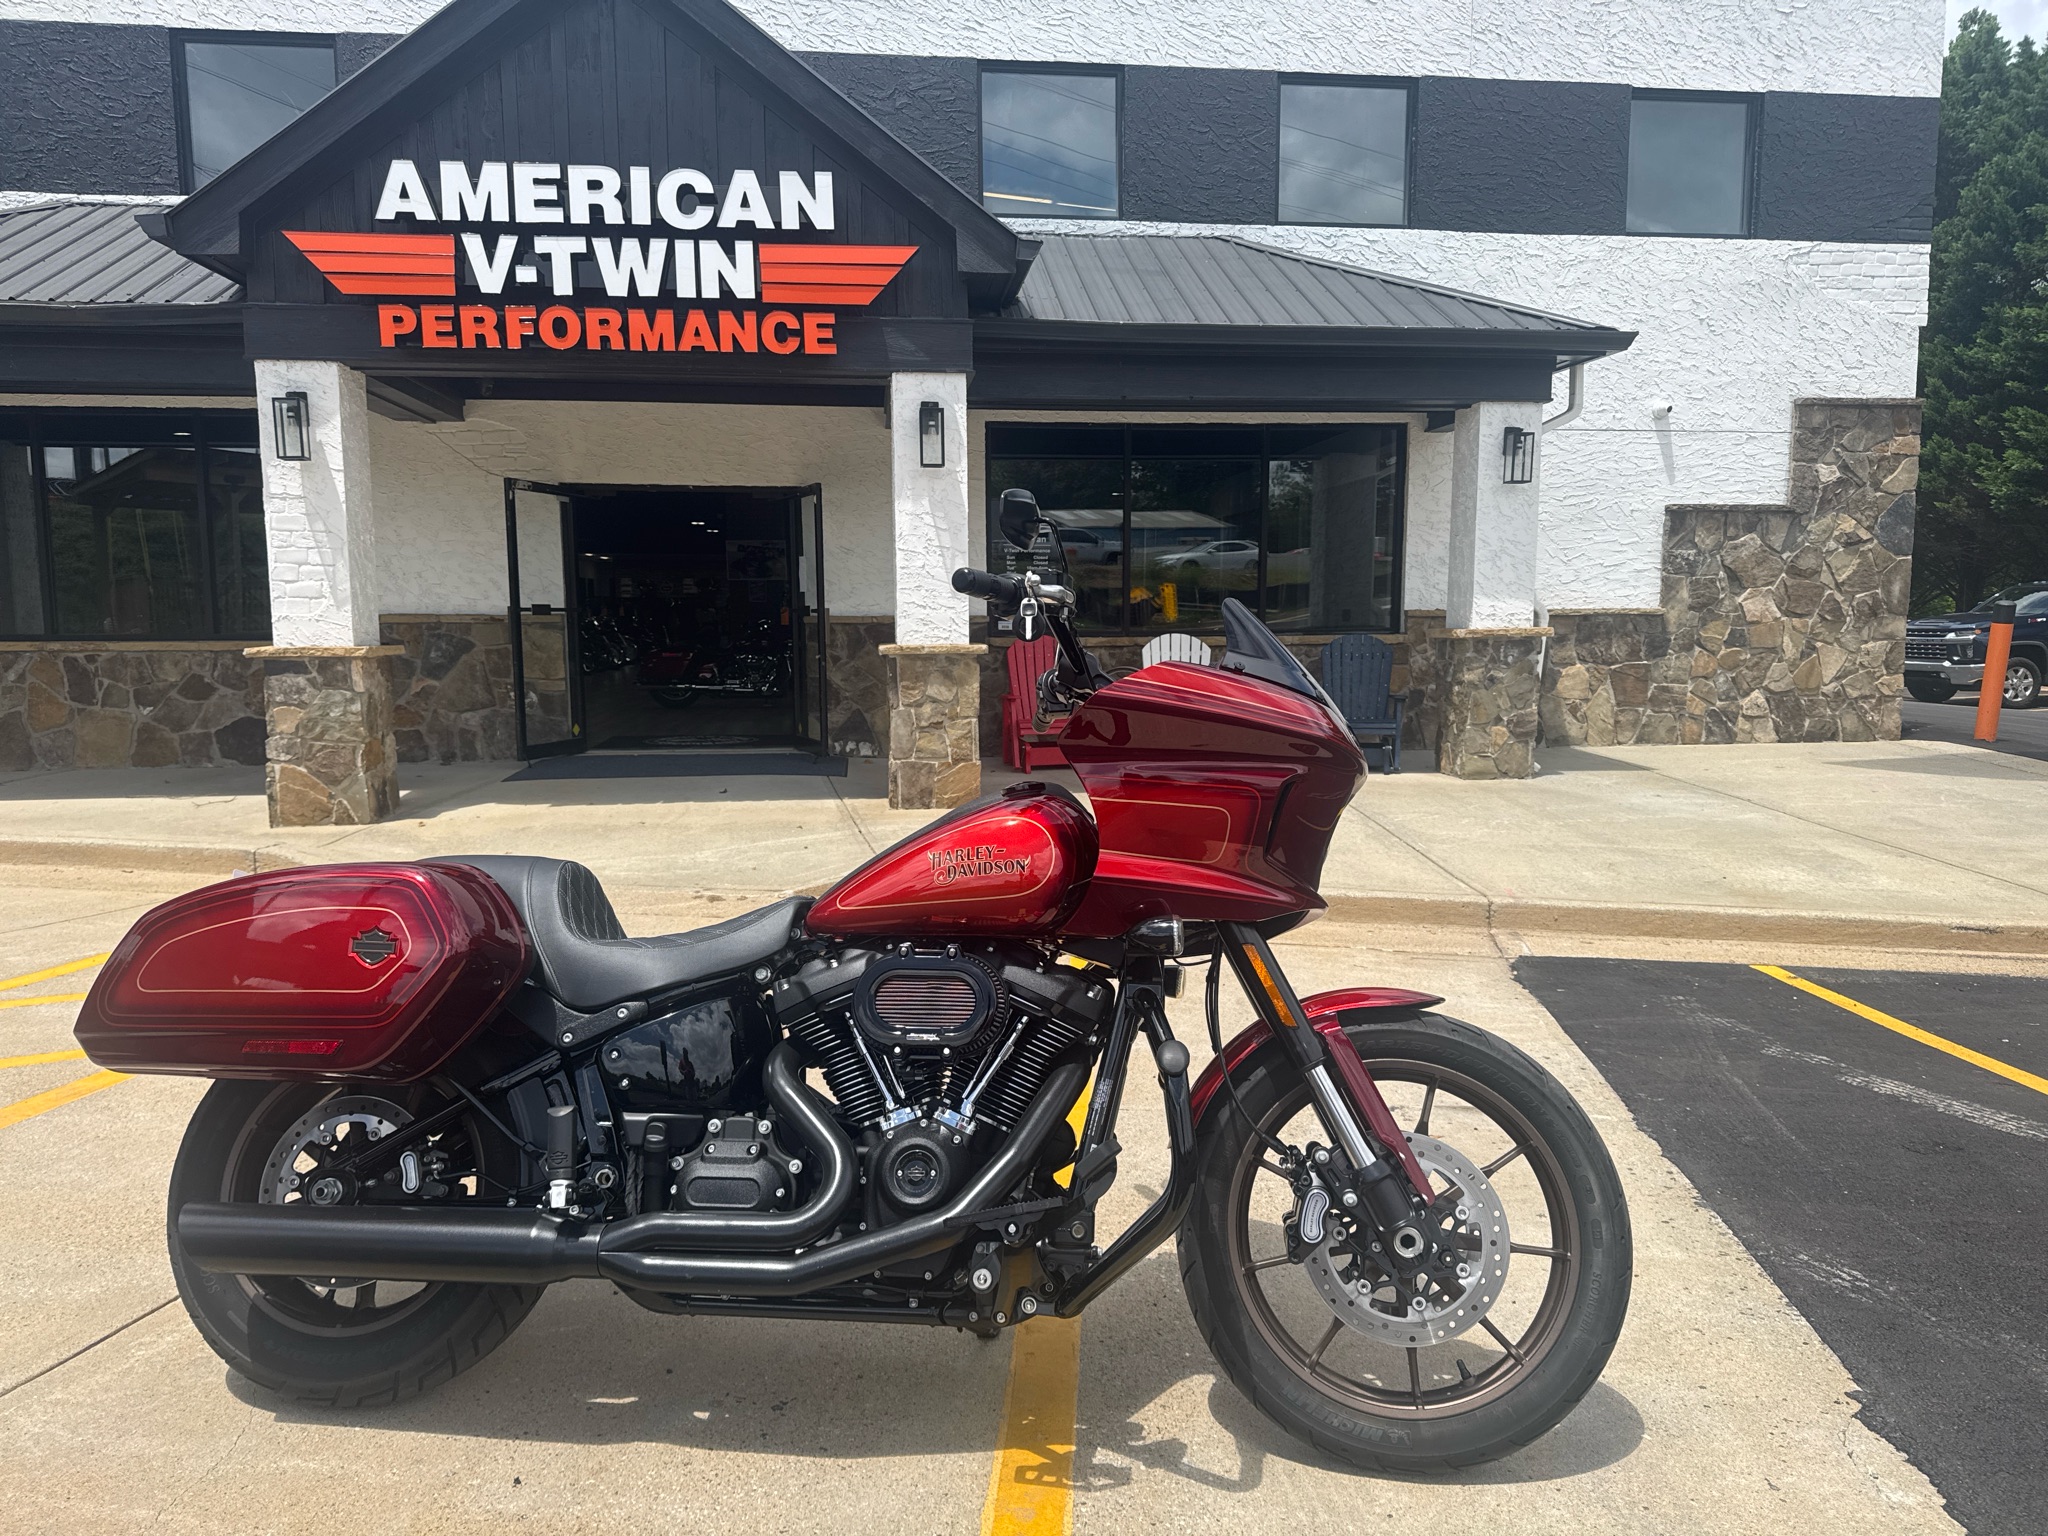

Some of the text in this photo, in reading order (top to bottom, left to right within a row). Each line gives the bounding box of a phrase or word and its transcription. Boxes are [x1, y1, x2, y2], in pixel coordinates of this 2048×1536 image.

[374, 159, 835, 230] AMERICAN
[460, 233, 757, 300] V-TWIN
[378, 304, 838, 355] PERFORMANCE
[927, 845, 1006, 872] HARLEY-
[934, 855, 1031, 886] DAVIDSON
[1580, 1271, 1603, 1334] SCORCHER
[1281, 1385, 1384, 1442] MICHELIN
